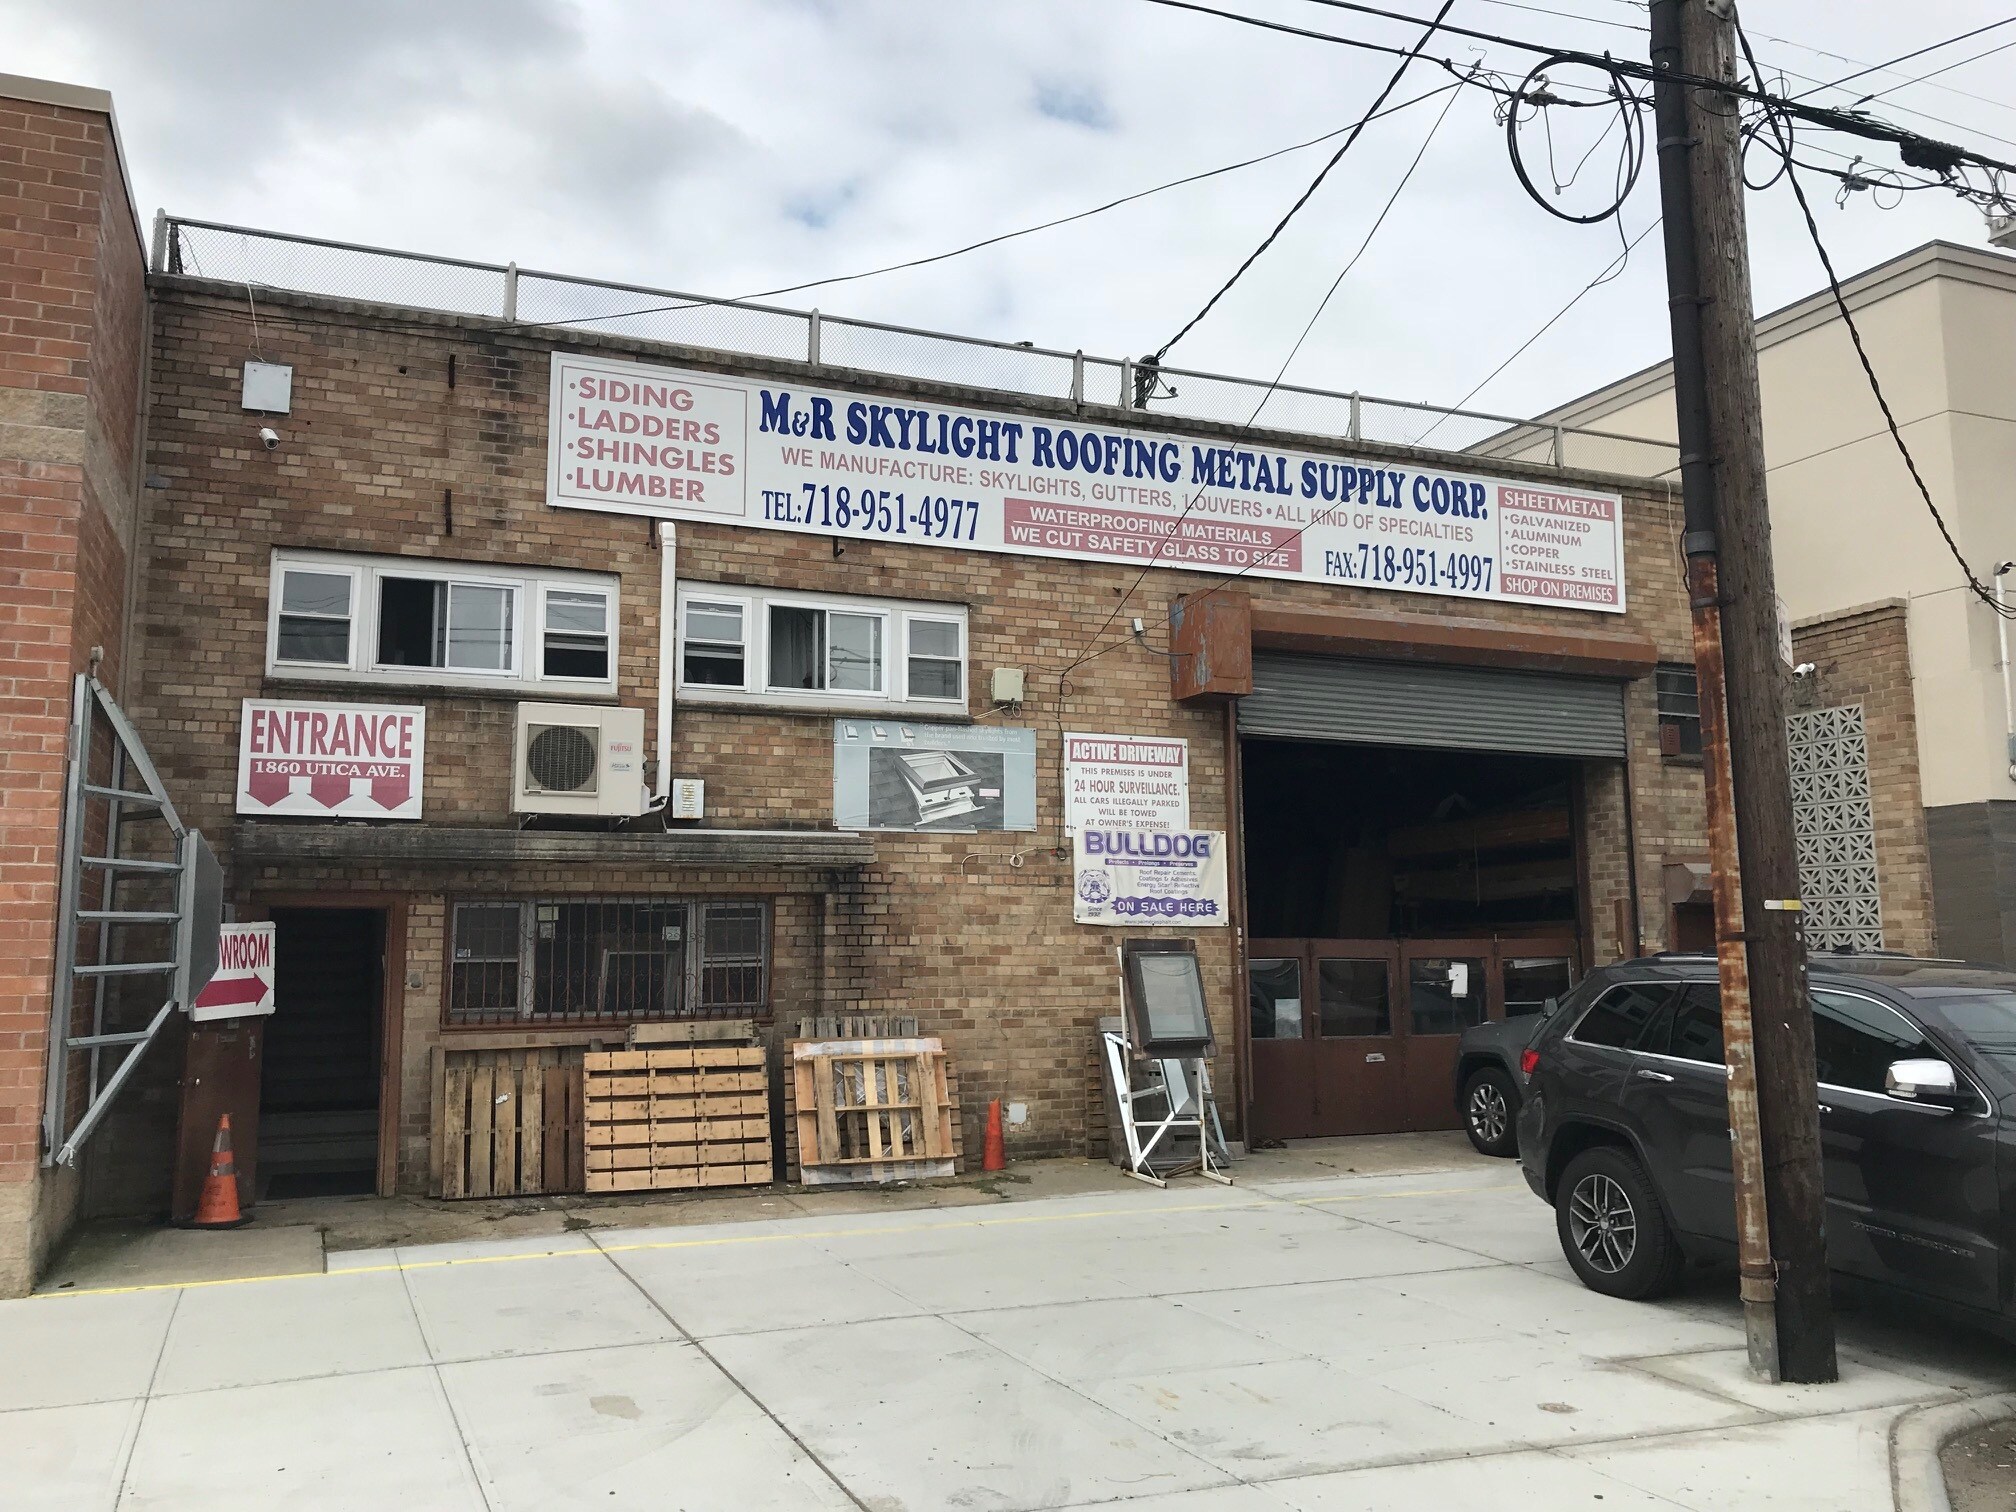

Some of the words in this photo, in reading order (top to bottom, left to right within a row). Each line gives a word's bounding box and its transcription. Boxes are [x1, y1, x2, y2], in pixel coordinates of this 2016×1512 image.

[578, 376, 694, 412] SIDING
[578, 406, 720, 445] LADDERS
[576, 436, 735, 476] SHINGLES
[759, 389, 837, 441] M&R
[846, 401, 1023, 464] SKYLIGHT
[1032, 426, 1182, 483] ROOFING
[1191, 445, 1293, 496] METAL
[1301, 460, 1406, 509] SUPPLY
[1412, 475, 1488, 521] CORP.
[576, 466, 706, 503] LUMBER
[781, 446, 813, 468] WE
[820, 451, 973, 486] MANUFACTURE:
[979, 470, 1086, 502] SKYLIGHTS,
[1091, 482, 1176, 511] GUTTERS,
[1184, 493, 1263, 518] LOUVERS
[1275, 504, 1306, 523] ALL
[1311, 508, 1348, 528] KIND
[1353, 513, 1374, 530] OF
[1378, 516, 1474, 543] SPECIALTIES
[1504, 490, 1610, 518] SHEETMETAL
[1029, 506, 1178, 536] WATERPROOFING
[1181, 522, 1273, 545] MATERIALS
[1510, 513, 1591, 534] GALVANIZED
[1010, 525, 1041, 543] WE
[1045, 528, 1083, 547] CUT
[1087, 533, 1158, 555] SAFETY
[1161, 542, 1220, 562] GLASS
[1224, 548, 1248, 564] TO
[1252, 550, 1290, 568] SIZE
[1510, 528, 1582, 547] ALUMINUM
[1511, 544, 1560, 559] COPPER
[1511, 559, 1576, 576] STAINLESS
[1581, 566, 1613, 580] STEEL
[1506, 577, 1538, 594] SHOP
[1541, 580, 1560, 597] ON
[1562, 583, 1613, 603] PREMISES
[250, 709, 414, 759] ENTRANCE
[610, 743, 632, 752] FUJITSU
[1072, 742, 1117, 760] ACTIVE
[1119, 744, 1182, 764] DRIVEWAY
[255, 761, 301, 774] 1860
[306, 762, 362, 776] UTICA
[366, 764, 405, 778] AVE.
[1081, 767, 1098, 775] THIS
[1101, 768, 1135, 777] PREMISES
[1138, 769, 1145, 777] IS
[1148, 770, 1173, 778] UNDER
[1074, 779, 1086, 792] 24
[1089, 780, 1116, 793] HOUR
[1119, 781, 1181, 796] SURVEILLANCE.
[1090, 797, 1110, 805] CARS
[1112, 798, 1149, 807] ILLEGALLY
[1151, 799, 1180, 808] PARKED
[1098, 808, 1116, 816] WILL
[1130, 810, 1158, 818] TOWED
[1085, 818, 1096, 826] AT
[1098, 819, 1133, 828] OWNER'S
[1135, 820, 1170, 829] EXPENSE!
[1084, 829, 1212, 858] BULLDOG
[1138, 875, 1163, 883] Coatings
[1154, 870, 1172, 878] Repair
[1117, 901, 1135, 912] ON
[1140, 902, 1174, 913] SALE
[1180, 902, 1213, 913] HERE
[219, 933, 270, 970] WROOM
